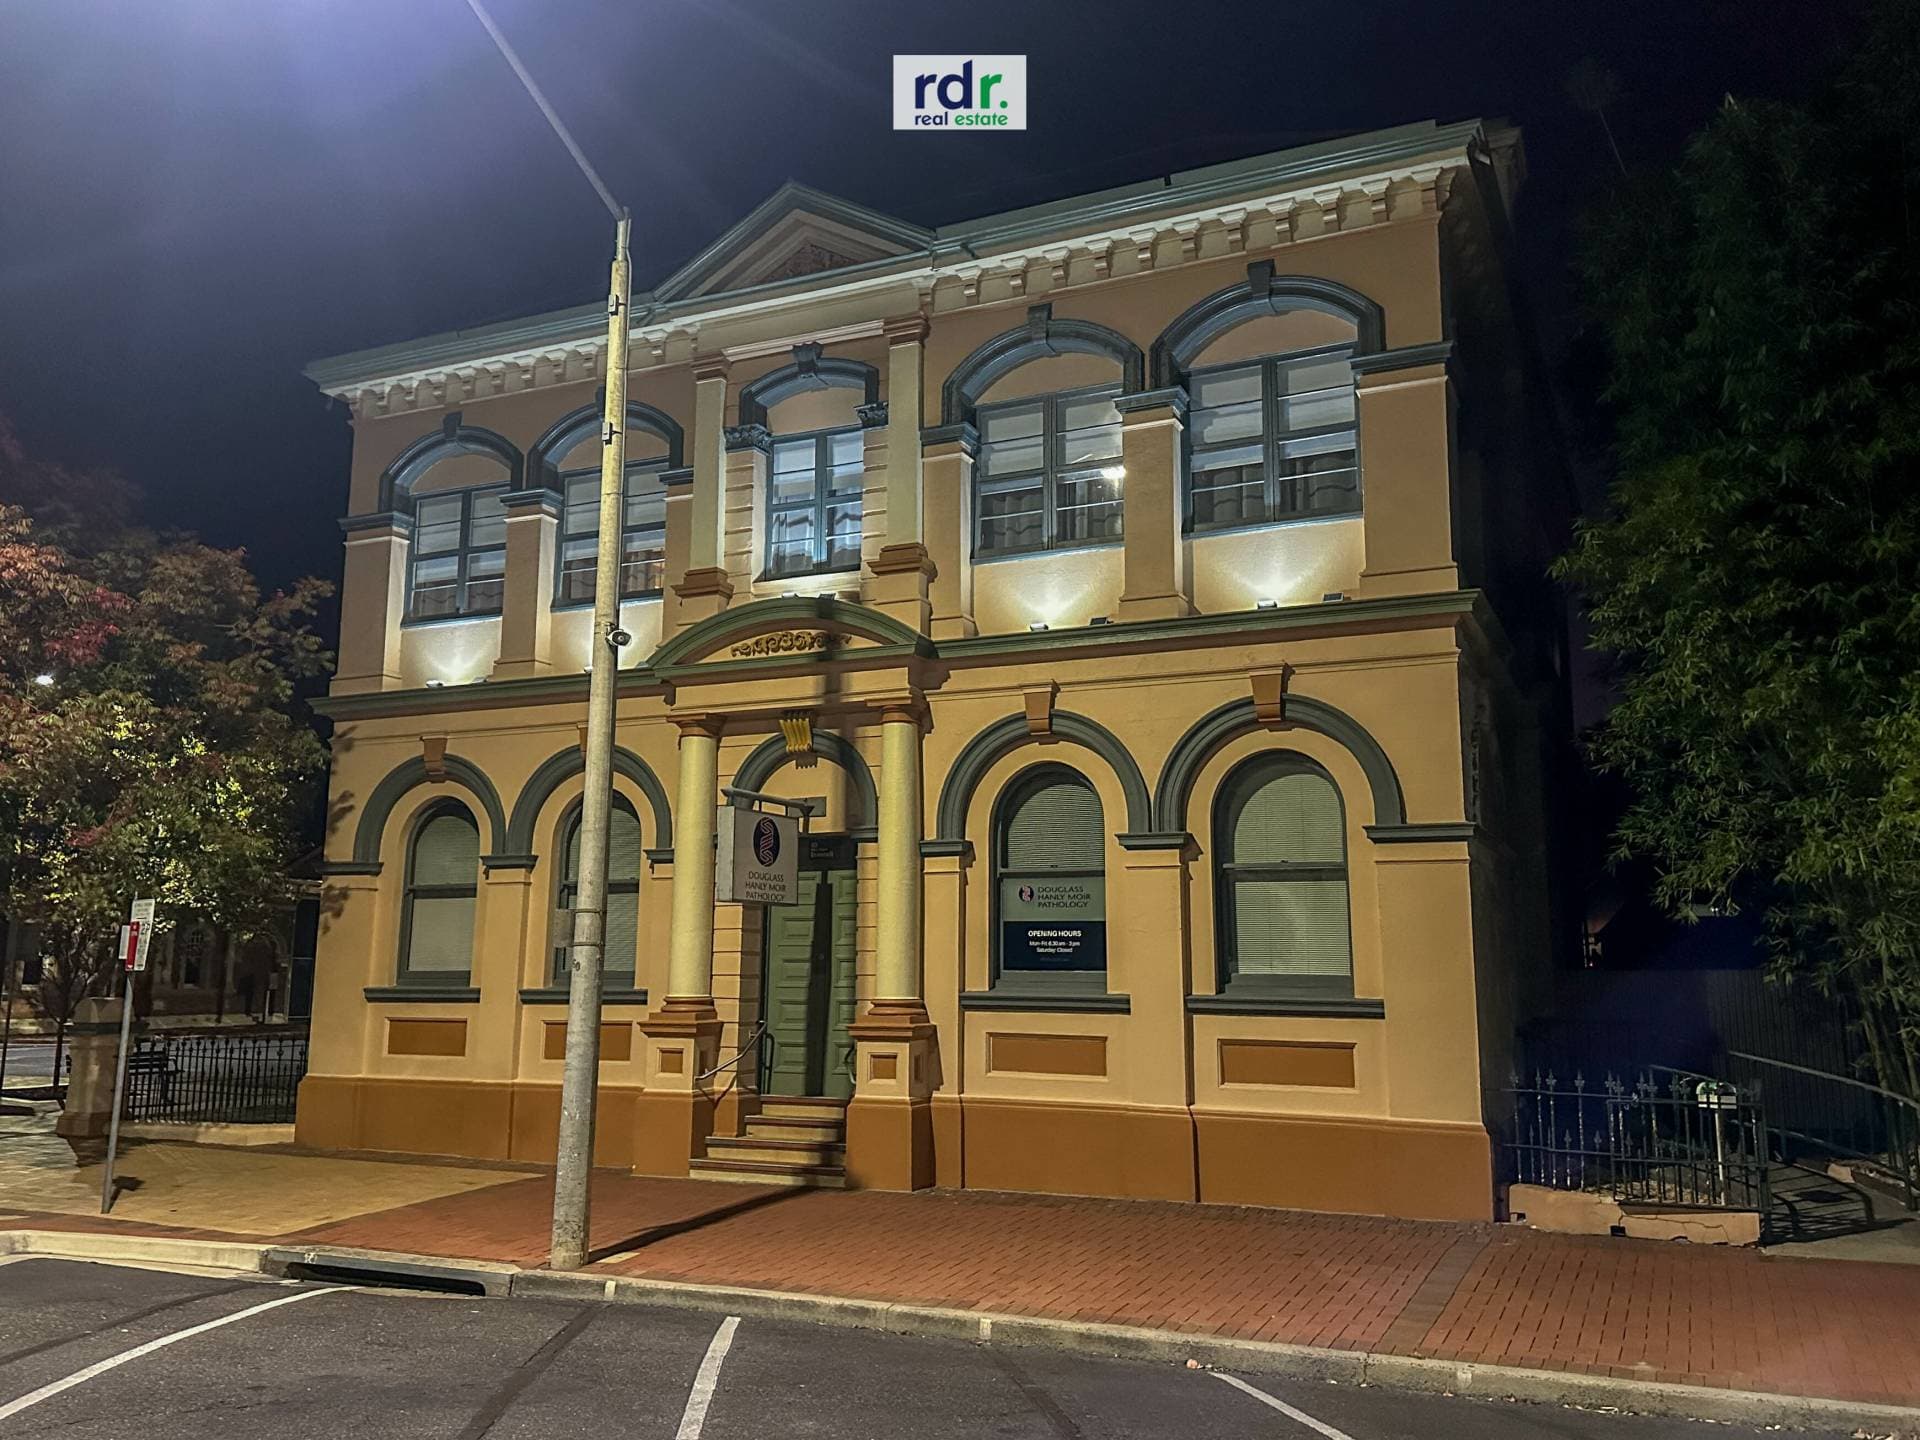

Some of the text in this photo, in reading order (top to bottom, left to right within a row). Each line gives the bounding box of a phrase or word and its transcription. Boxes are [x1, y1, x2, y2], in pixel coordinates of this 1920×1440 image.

[748, 870, 784, 882] DOUGLASS
[745, 881, 786, 892] HANLY MOIR
[745, 890, 785, 902] PATHOLOGY
